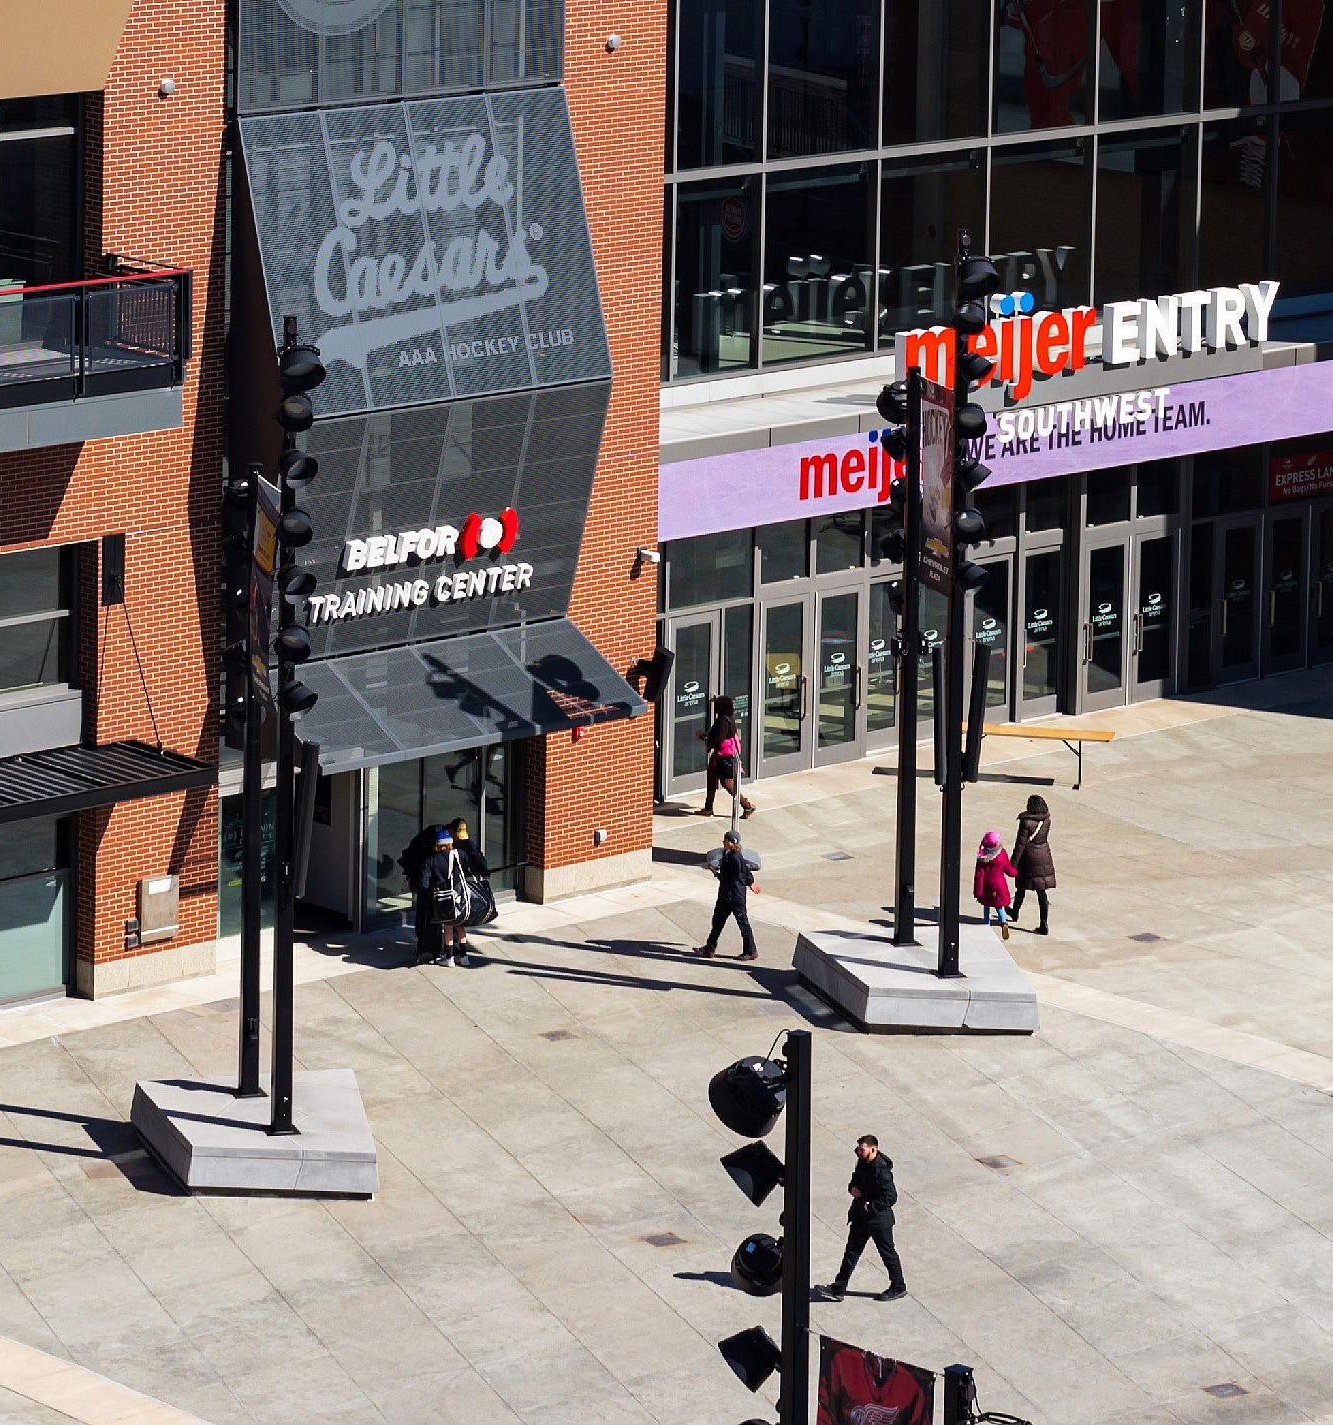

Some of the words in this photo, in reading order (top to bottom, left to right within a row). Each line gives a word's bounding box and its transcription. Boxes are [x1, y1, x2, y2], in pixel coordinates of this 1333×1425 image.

[338, 134, 514, 226] Little
[314, 225, 536, 317] Caesars
[398, 347, 437, 367] AAA
[447, 335, 519, 361] HOCKEY
[528, 328, 574, 350] CLUB
[896, 291, 1097, 400] meijer
[1103, 280, 1281, 365] ENTRY
[968, 434, 997, 461] WE
[1001, 430, 1041, 458] ARE
[1048, 422, 1082, 451] THE
[1089, 418, 1146, 444] HOME
[997, 387, 1171, 444] SOUTHWEST
[799, 428, 908, 503] meij
[1275, 468, 1316, 486] EXPRESS
[343, 525, 460, 571] BELFOR
[308, 578, 430, 624] TRAINING
[434, 562, 534, 602] CENTER
